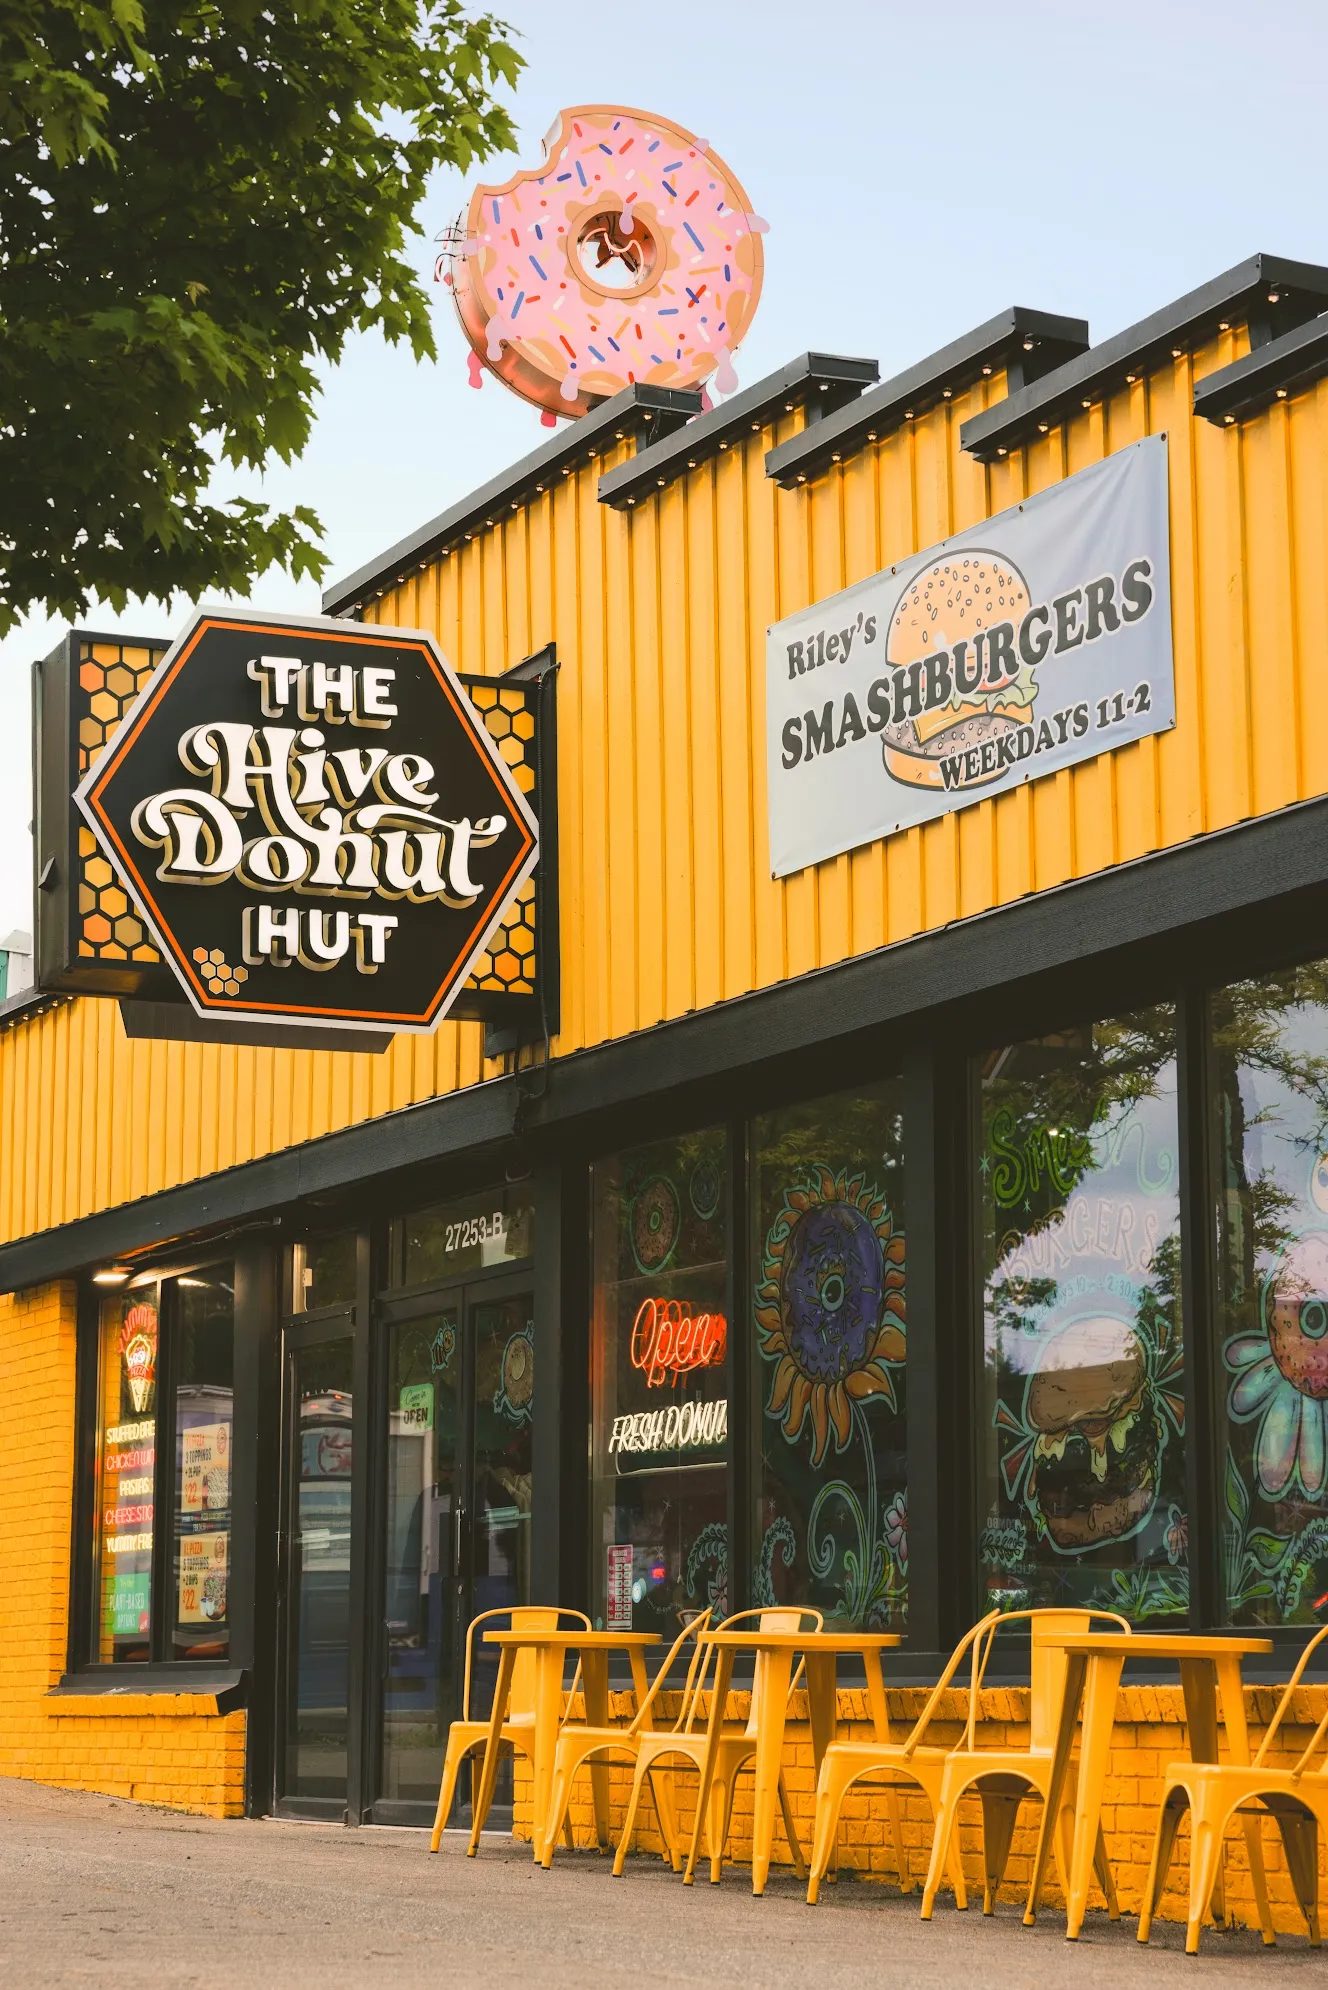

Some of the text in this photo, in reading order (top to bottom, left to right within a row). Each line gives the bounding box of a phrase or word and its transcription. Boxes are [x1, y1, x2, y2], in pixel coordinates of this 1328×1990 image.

[780, 559, 1153, 770] SMASHBURGERS
[786, 611, 877, 680] Riley's
[252, 656, 399, 720] THE
[186, 721, 441, 812] Hive
[939, 682, 1152, 791] WEEKDAYS 11-2
[142, 788, 508, 897] Donut
[252, 905, 399, 966] HUT
[445, 1211, 505, 1253] 27253-B
[997, 1196, 1160, 1303] BURGERS
[631, 1298, 721, 1388] Open
[404, 1407, 429, 1424] OPEN
[608, 1409, 665, 1453] FRESH
[105, 1507, 137, 1525] CHEESE
